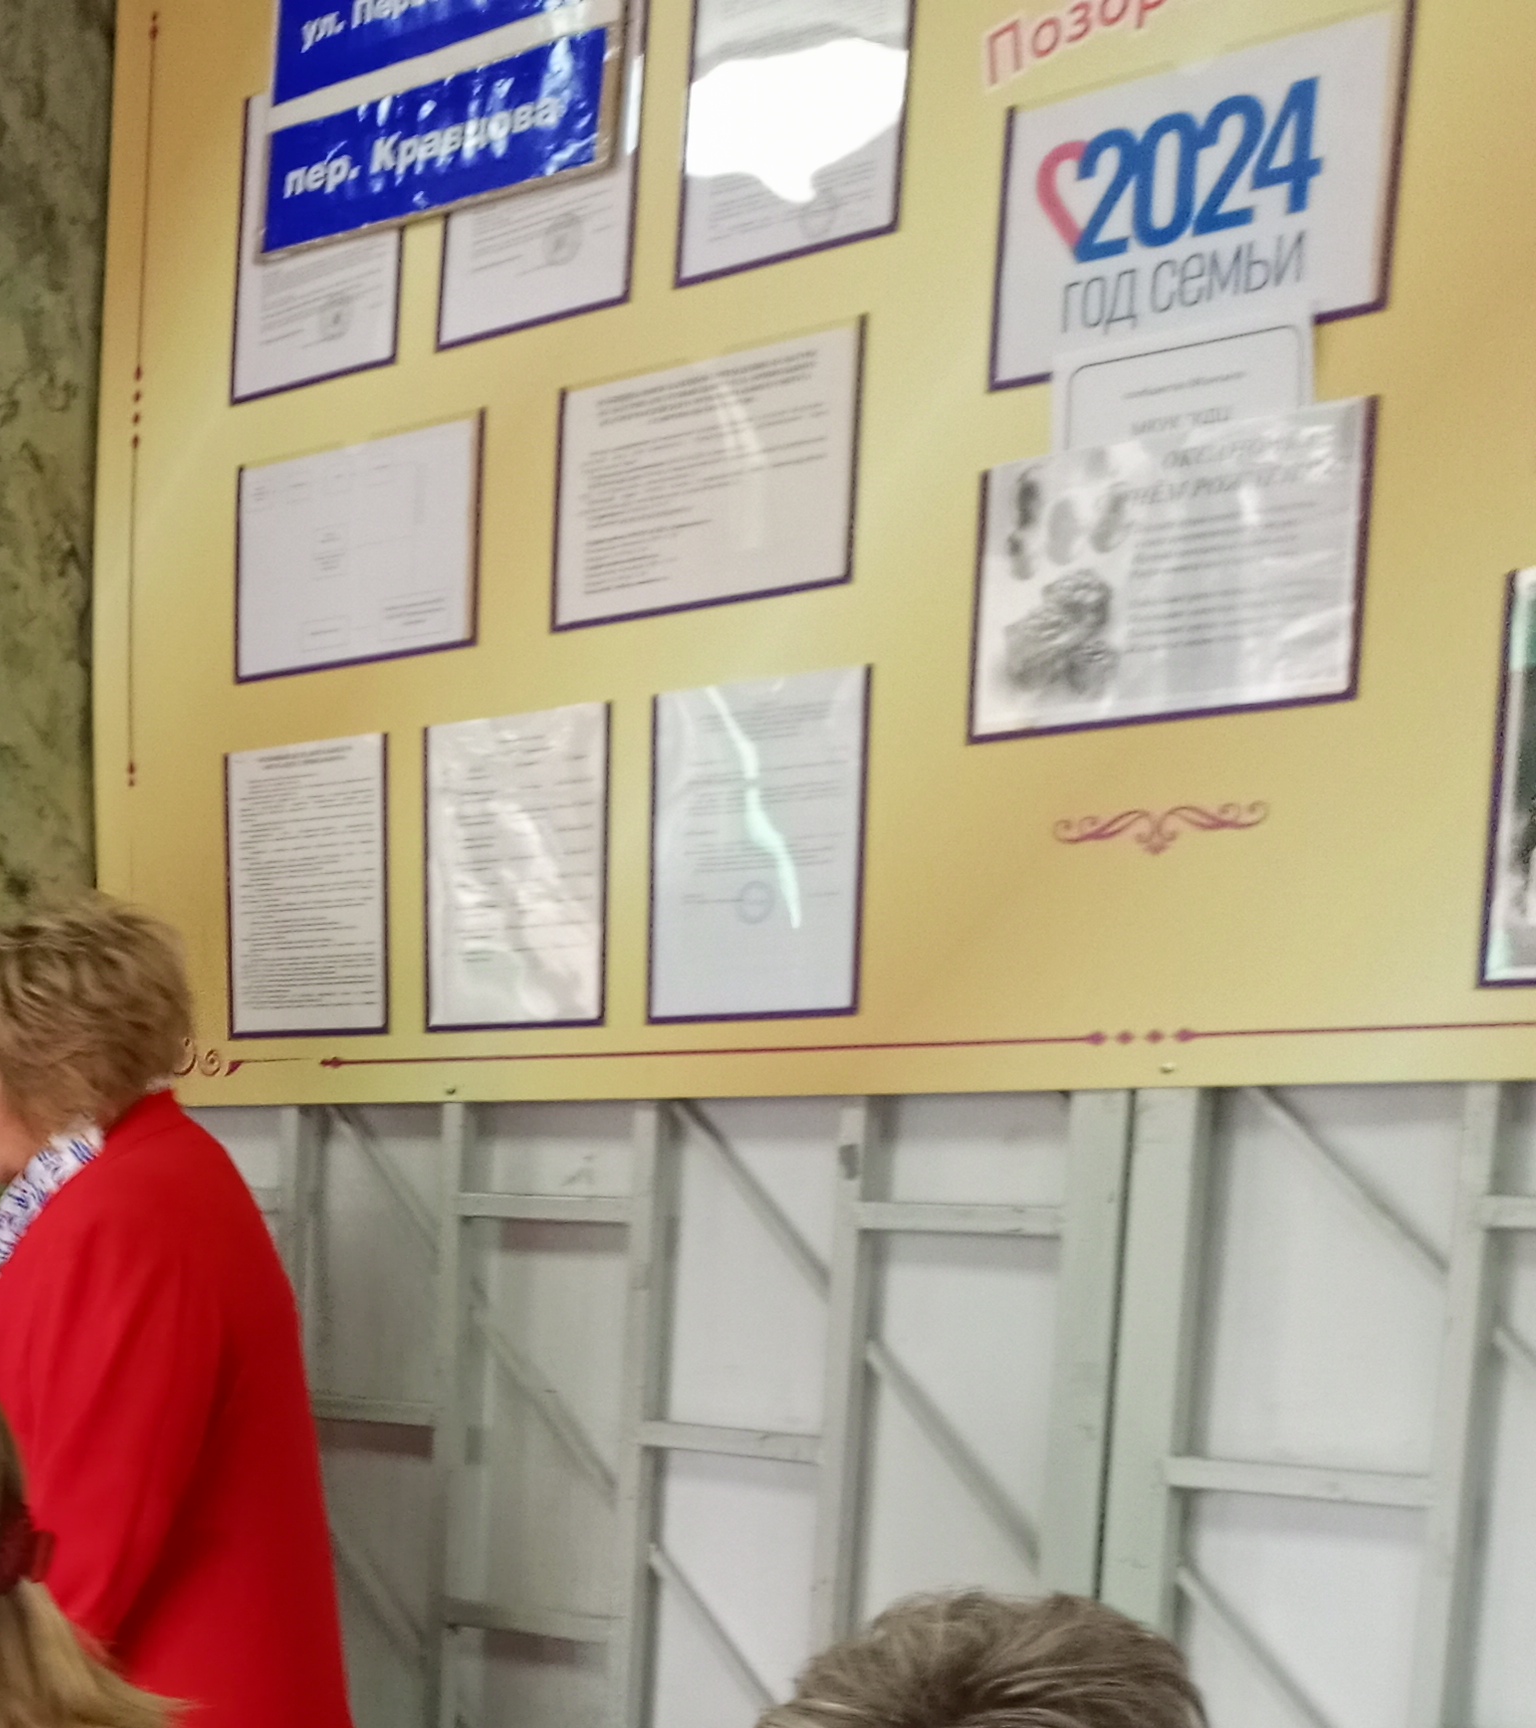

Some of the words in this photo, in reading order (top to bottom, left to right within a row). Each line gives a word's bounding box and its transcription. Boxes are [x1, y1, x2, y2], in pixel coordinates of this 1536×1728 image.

[300, 11, 347, 54] ул.
[350, 0, 428, 30] Пер
[283, 153, 361, 199] пер.
[369, 98, 561, 175] Кравцова
[1073, 75, 1324, 264] 2024
[1060, 267, 1138, 335] ГОД
